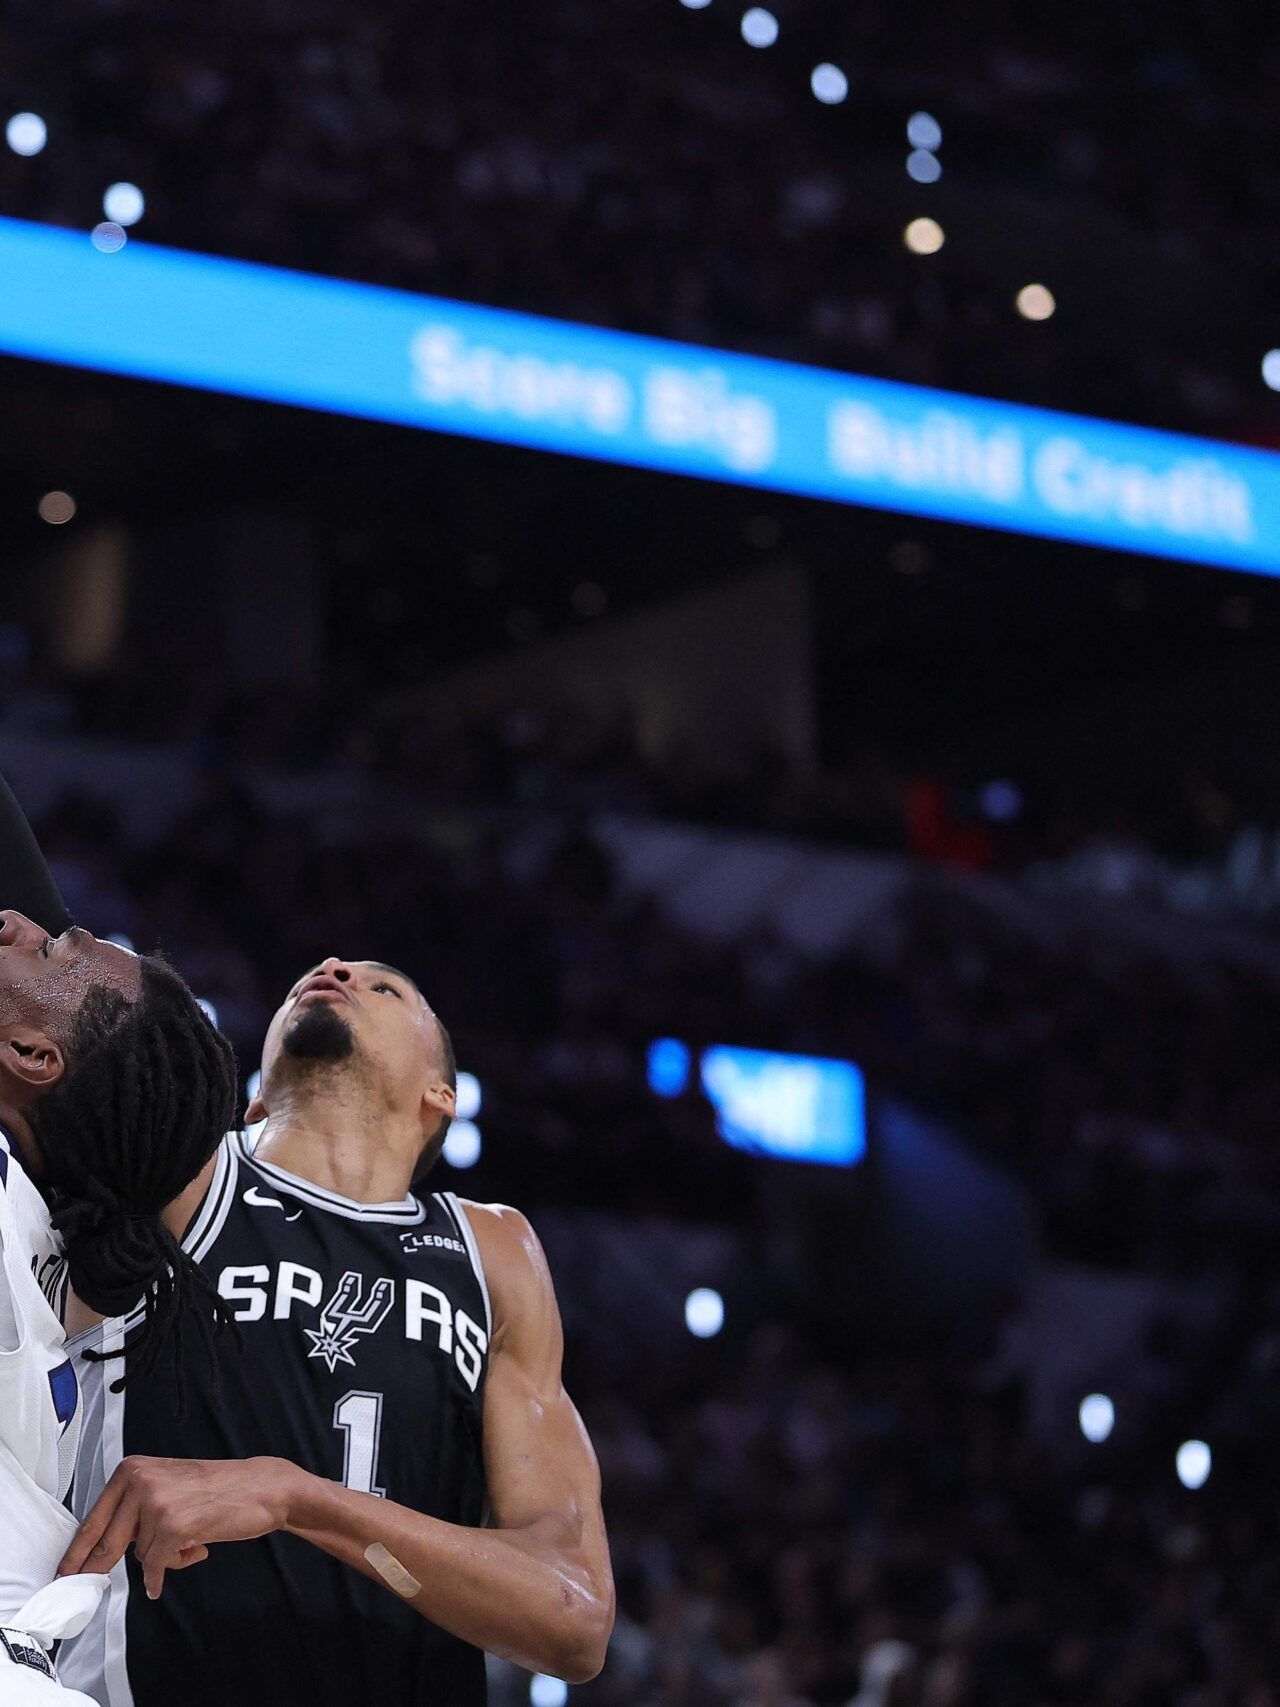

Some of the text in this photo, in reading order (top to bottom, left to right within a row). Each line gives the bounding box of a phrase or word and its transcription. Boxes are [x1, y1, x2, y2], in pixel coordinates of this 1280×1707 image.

[645, 364, 778, 473] Big
[827, 401, 1023, 504] Build
[1033, 437, 1257, 546] Credit
[216, 1261, 489, 1393] SPURS
[332, 1389, 387, 1499] 1
